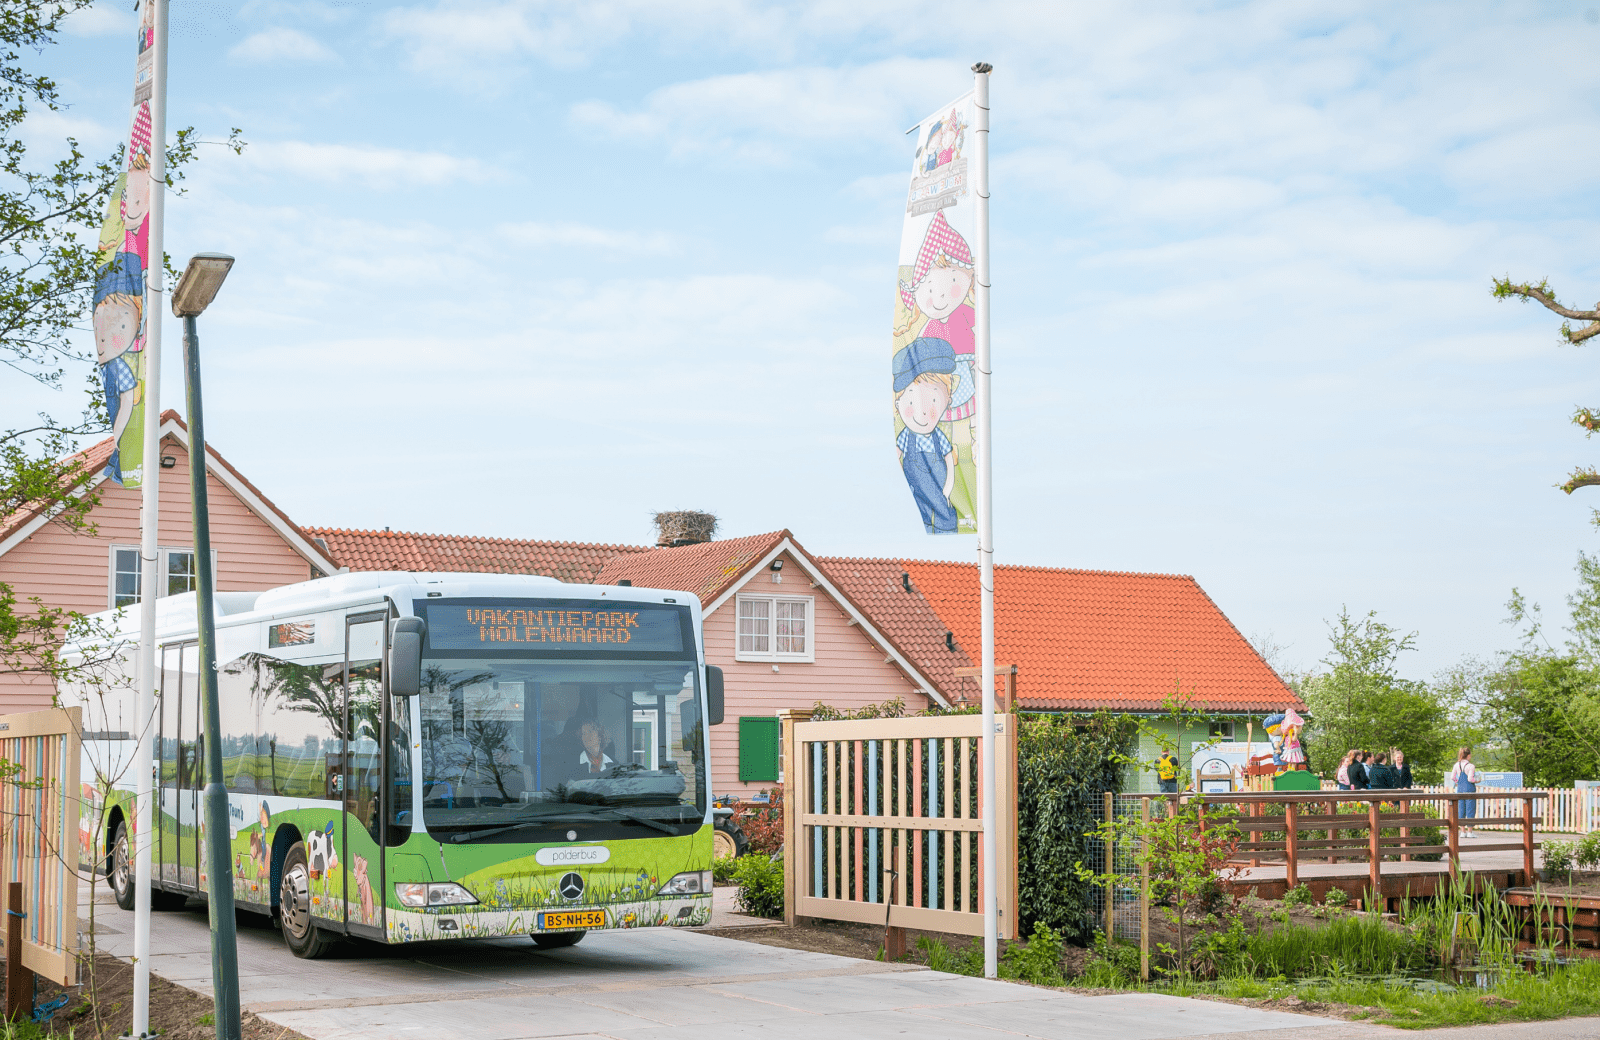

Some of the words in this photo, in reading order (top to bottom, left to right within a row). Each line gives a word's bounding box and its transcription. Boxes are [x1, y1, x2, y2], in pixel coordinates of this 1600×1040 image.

[466, 609, 640, 627] VAKANTIEPARK
[479, 627, 631, 643] MOLENWAARD
[552, 849, 597, 863] polderbus
[547, 914, 601, 926] BS-NH-56
